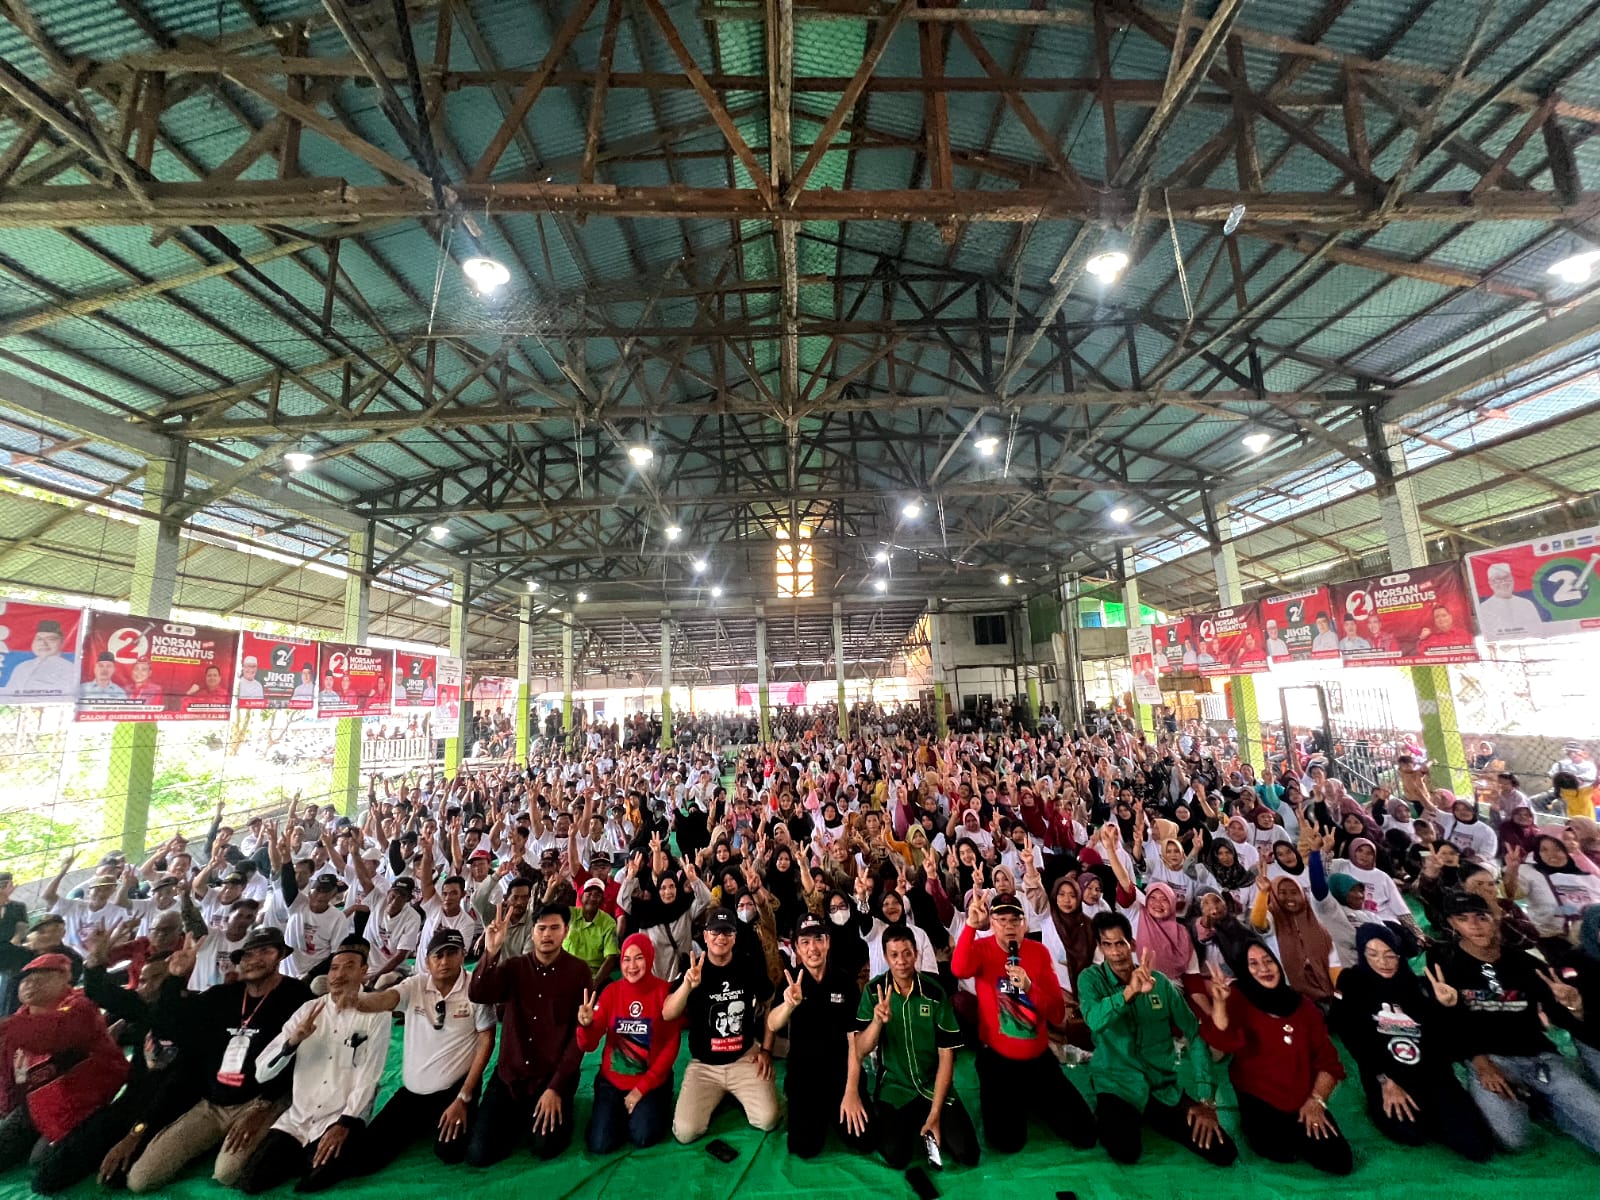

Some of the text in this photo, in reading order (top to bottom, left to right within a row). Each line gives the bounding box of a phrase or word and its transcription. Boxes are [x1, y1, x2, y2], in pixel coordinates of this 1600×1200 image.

[1374, 584, 1418, 600] NORSAN
[1547, 570, 1583, 602] 2
[1351, 592, 1369, 616] 2
[1375, 590, 1437, 608] KRISANTUS
[1289, 606, 1301, 622] 2
[1203, 621, 1213, 638] 2
[1215, 617, 1238, 627] NORSAN
[1168, 630, 1176, 642] 2
[1284, 625, 1312, 638] JIKIR
[117, 631, 140, 659] 2
[152, 635, 201, 649] NORSAN
[151, 645, 215, 659] KRISANTUS
[276, 649, 288, 666] 2
[333, 655, 345, 674] 2
[412, 662, 420, 675] 2
[264, 671, 295, 683] JIKIR
[722, 981, 730, 993] 2
[632, 1004, 640, 1014] 2
